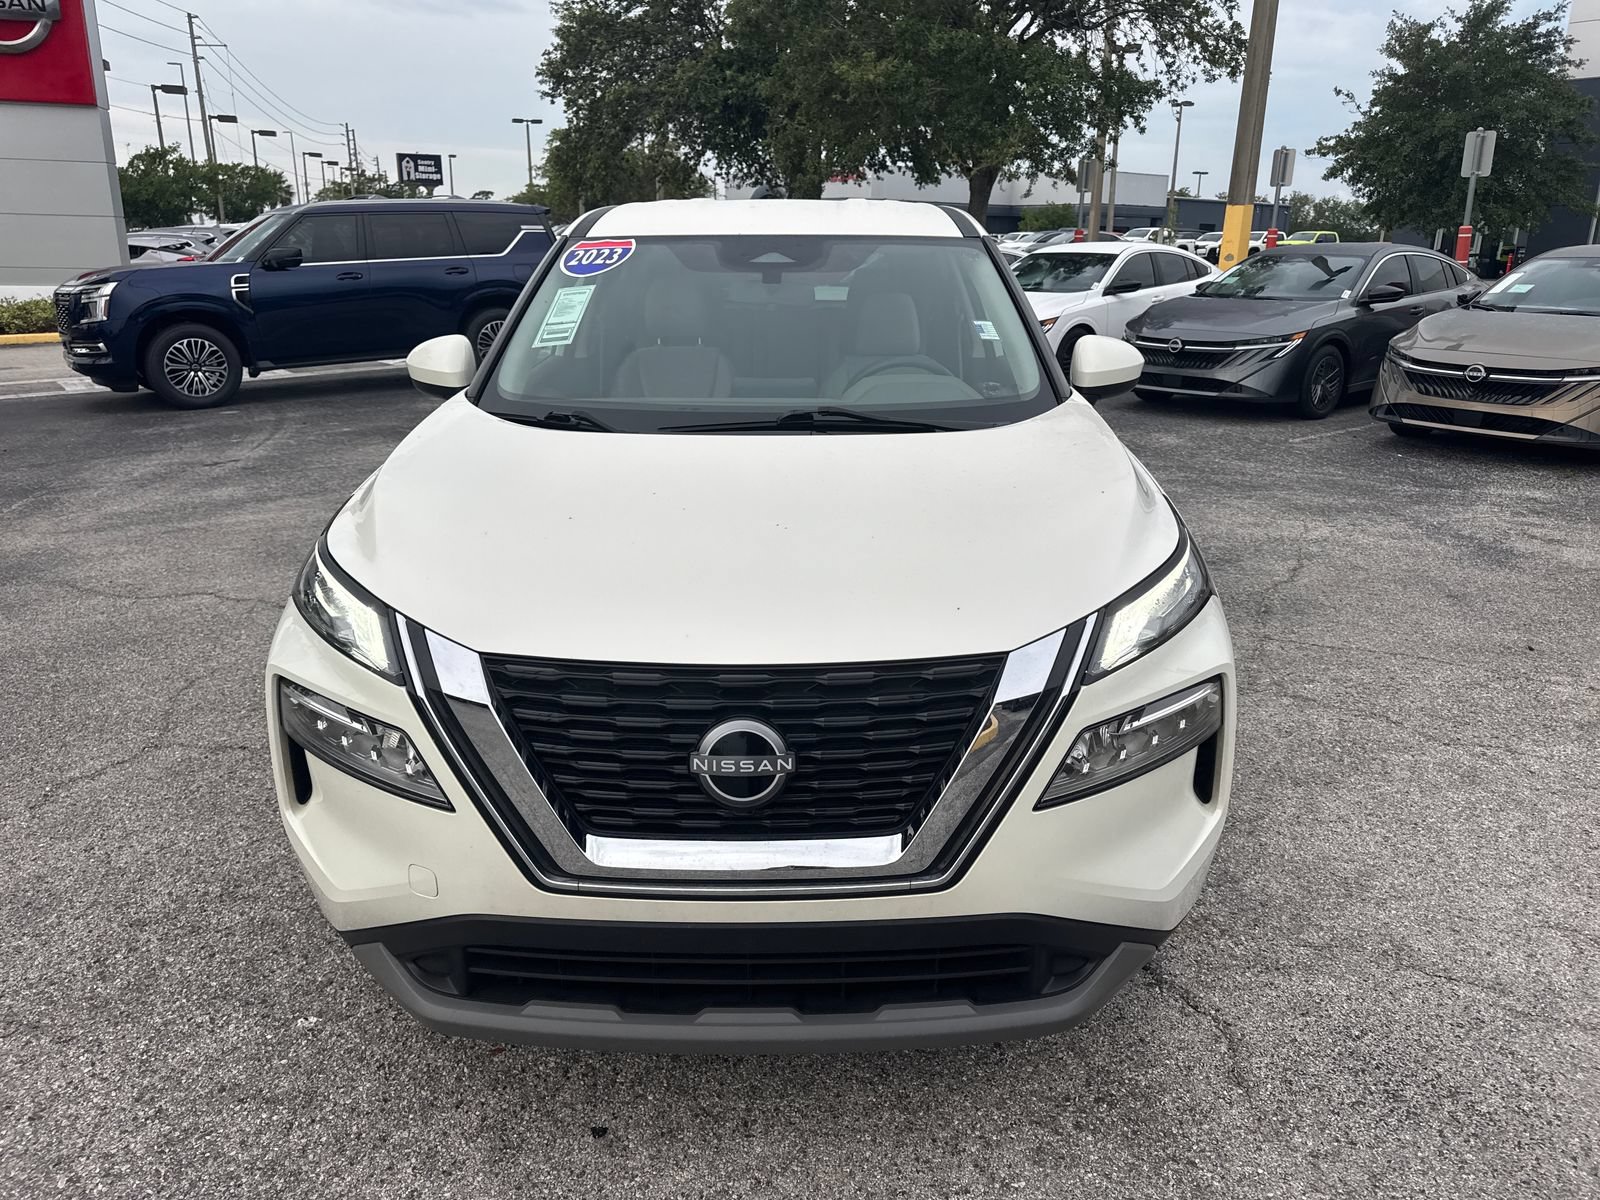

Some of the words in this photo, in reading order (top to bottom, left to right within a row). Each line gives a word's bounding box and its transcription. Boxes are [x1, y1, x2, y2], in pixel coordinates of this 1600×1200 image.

[0, 0, 47, 12] AN
[415, 172, 441, 180] Storage
[567, 248, 623, 266] 2023
[693, 757, 792, 772] NISSAN
